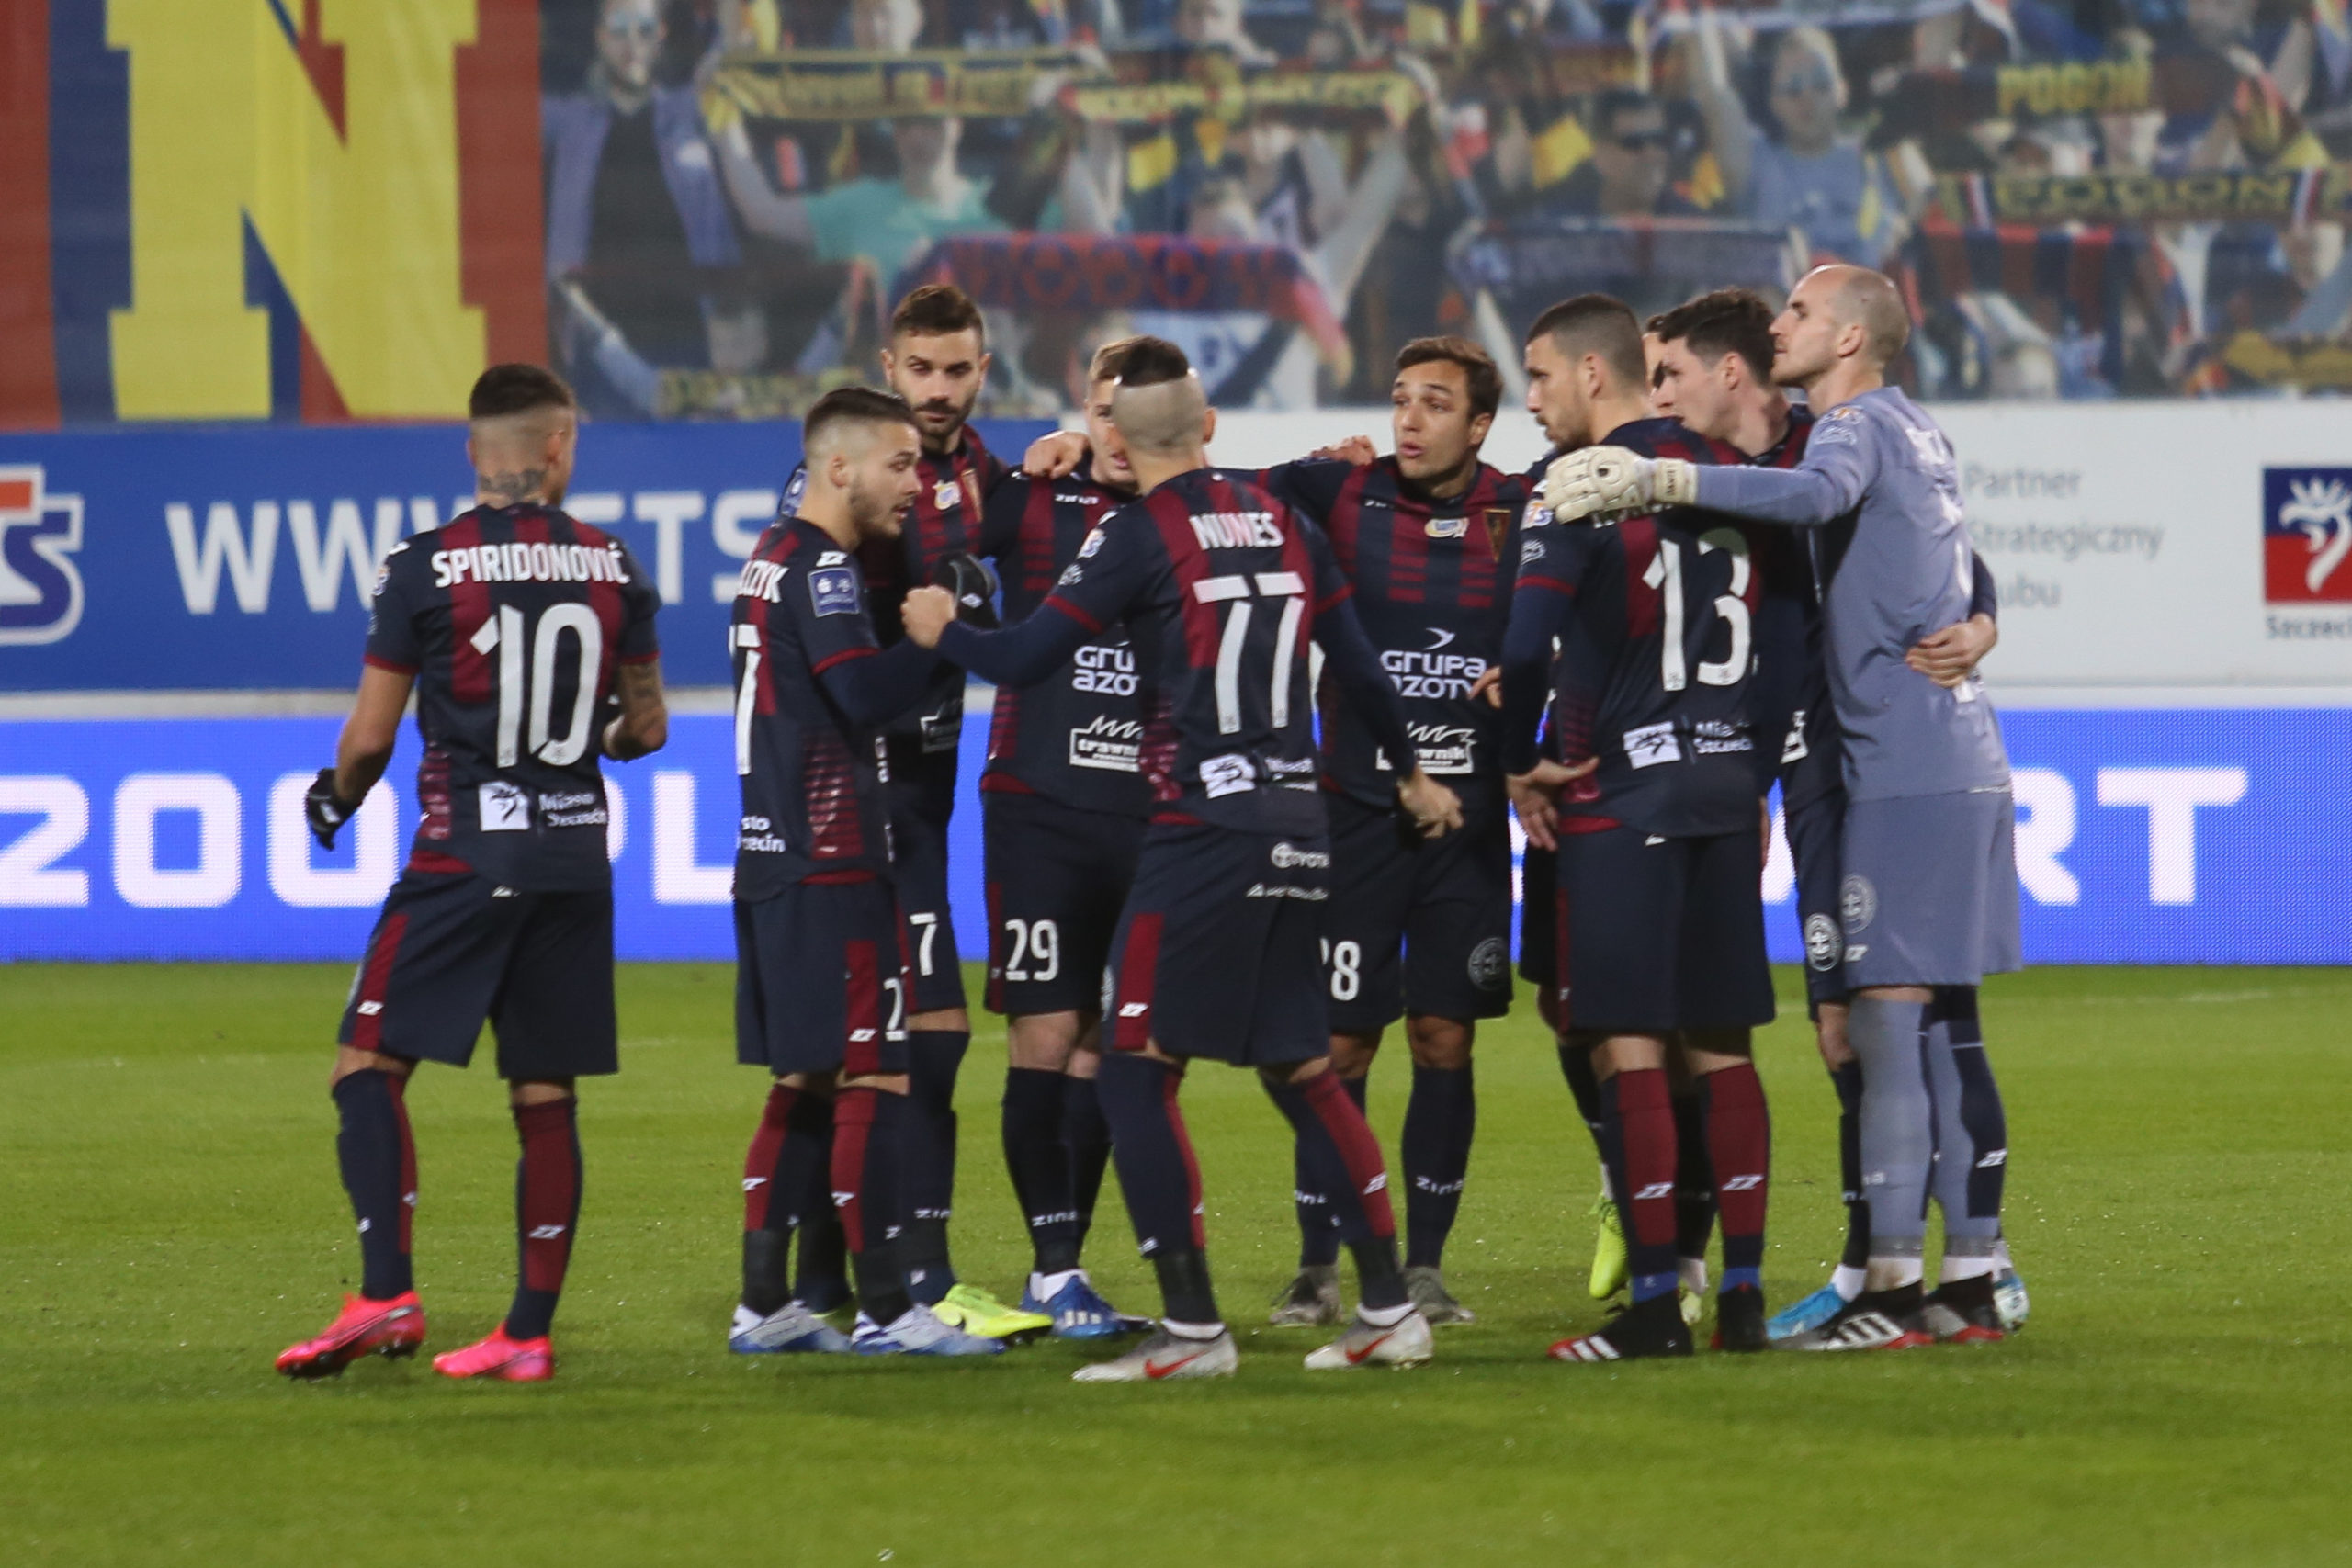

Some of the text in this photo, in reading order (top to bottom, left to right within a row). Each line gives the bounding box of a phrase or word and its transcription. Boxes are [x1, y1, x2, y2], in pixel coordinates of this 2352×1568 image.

[104, 0, 487, 421] N
[1963, 463, 2081, 500] Partner
[1189, 511, 1285, 550] NUNES
[431, 541, 630, 589] SPIRIDONOVIĆ
[1996, 571, 2062, 608] ubu
[1642, 527, 1752, 693] 13
[2265, 614, 2352, 640] Szczec
[469, 602, 603, 768] 10
[1193, 571, 1306, 736] 77
[1005, 919, 1059, 982] 29
[1320, 936, 1361, 1001] 8
